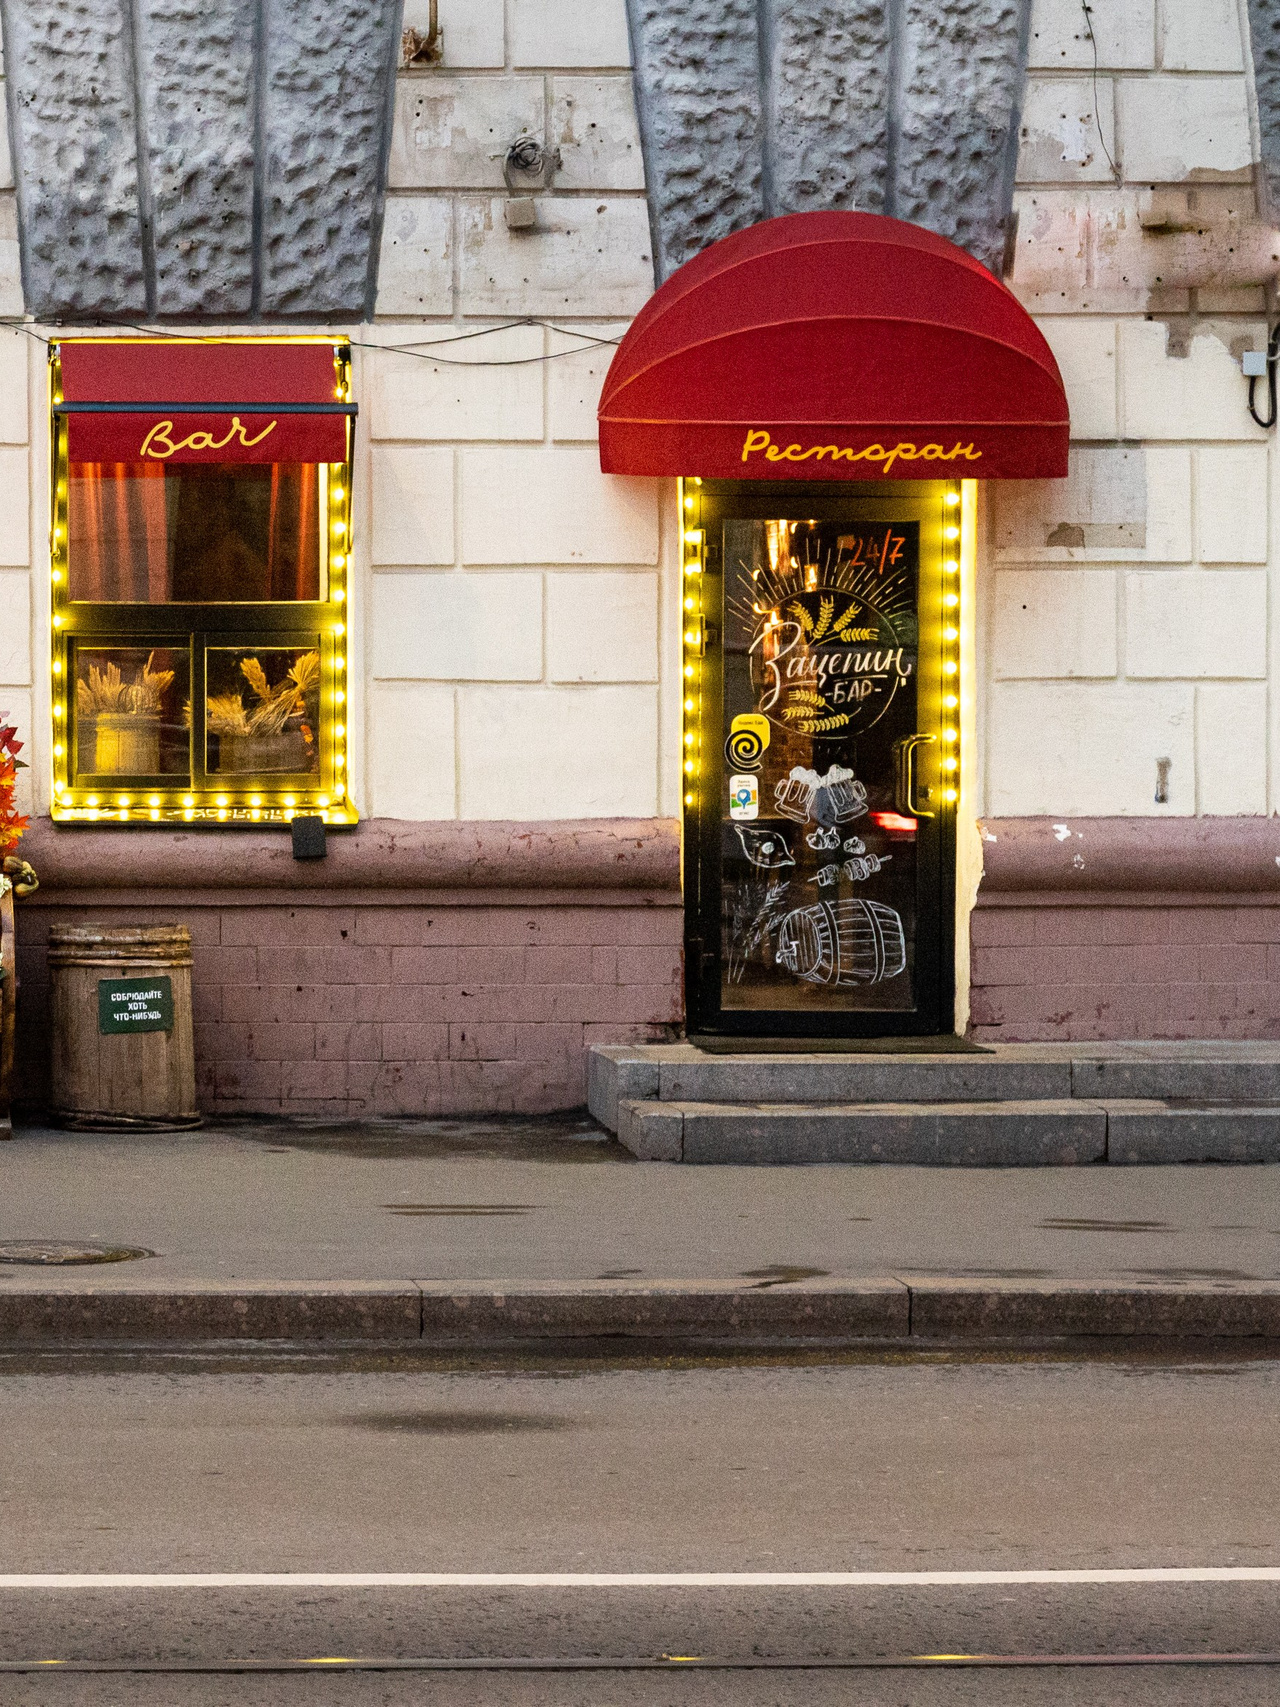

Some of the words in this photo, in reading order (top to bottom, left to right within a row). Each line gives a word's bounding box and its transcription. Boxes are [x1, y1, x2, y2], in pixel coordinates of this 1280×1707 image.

[140, 416, 278, 459] Bar
[741, 429, 983, 474] Ресторан
[849, 528, 906, 575] 24/7
[111, 990, 163, 1001] СОБЛЮДАЙТЕ
[128, 1002, 148, 1011] ХОТЬ
[113, 1011, 162, 1021] ЧТО-НИБУДЬ
